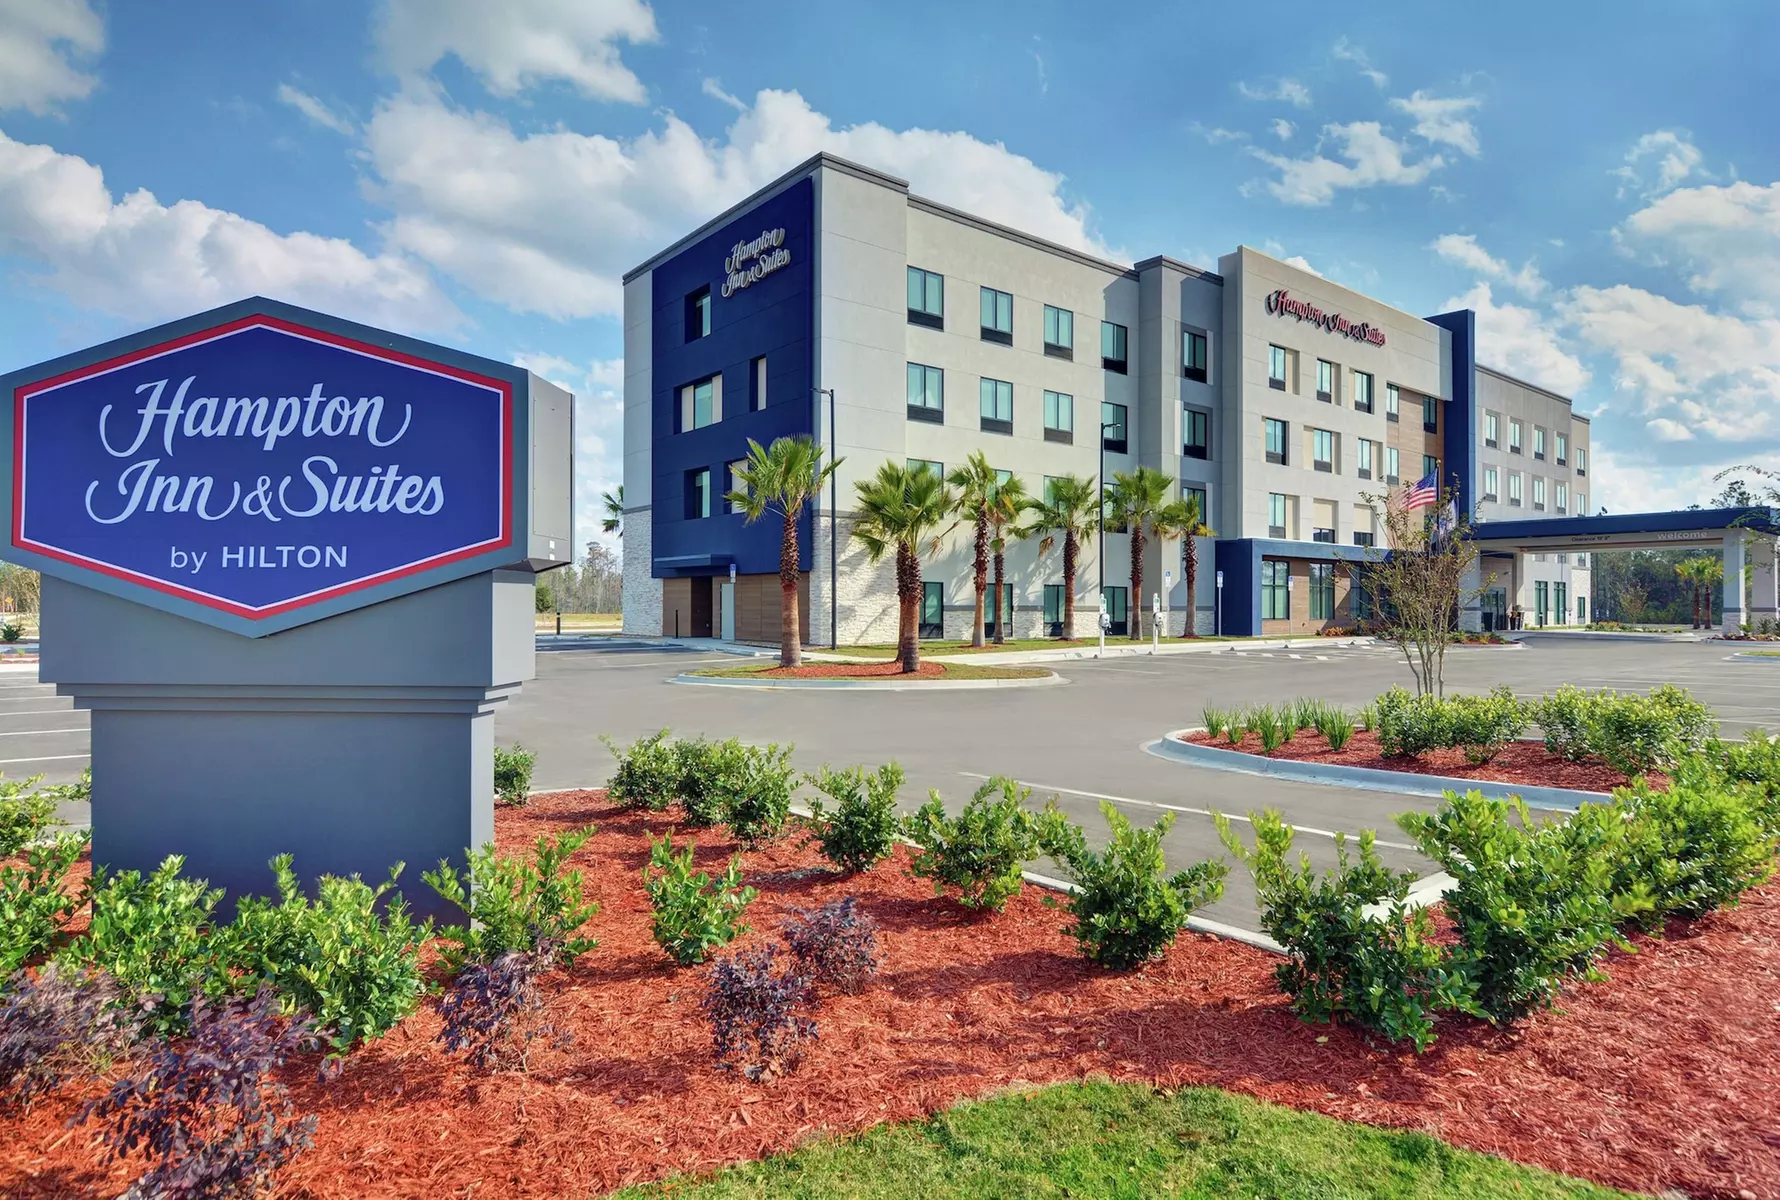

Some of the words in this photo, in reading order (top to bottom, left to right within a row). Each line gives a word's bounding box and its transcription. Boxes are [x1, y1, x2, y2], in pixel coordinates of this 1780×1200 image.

[721, 270, 750, 297] Inn
[755, 248, 791, 278] Suites
[725, 228, 785, 274] Hampton
[1264, 289, 1327, 328] Hampton
[1325, 312, 1354, 337] Inn
[1359, 322, 1386, 347] Suites
[100, 376, 411, 457] Hampton
[86, 459, 240, 523] Inn
[243, 476, 281, 521] &
[279, 456, 443, 516] Suites
[171, 547, 207, 573] by
[222, 546, 347, 568] HILTON
[1657, 531, 1708, 540] welcome
